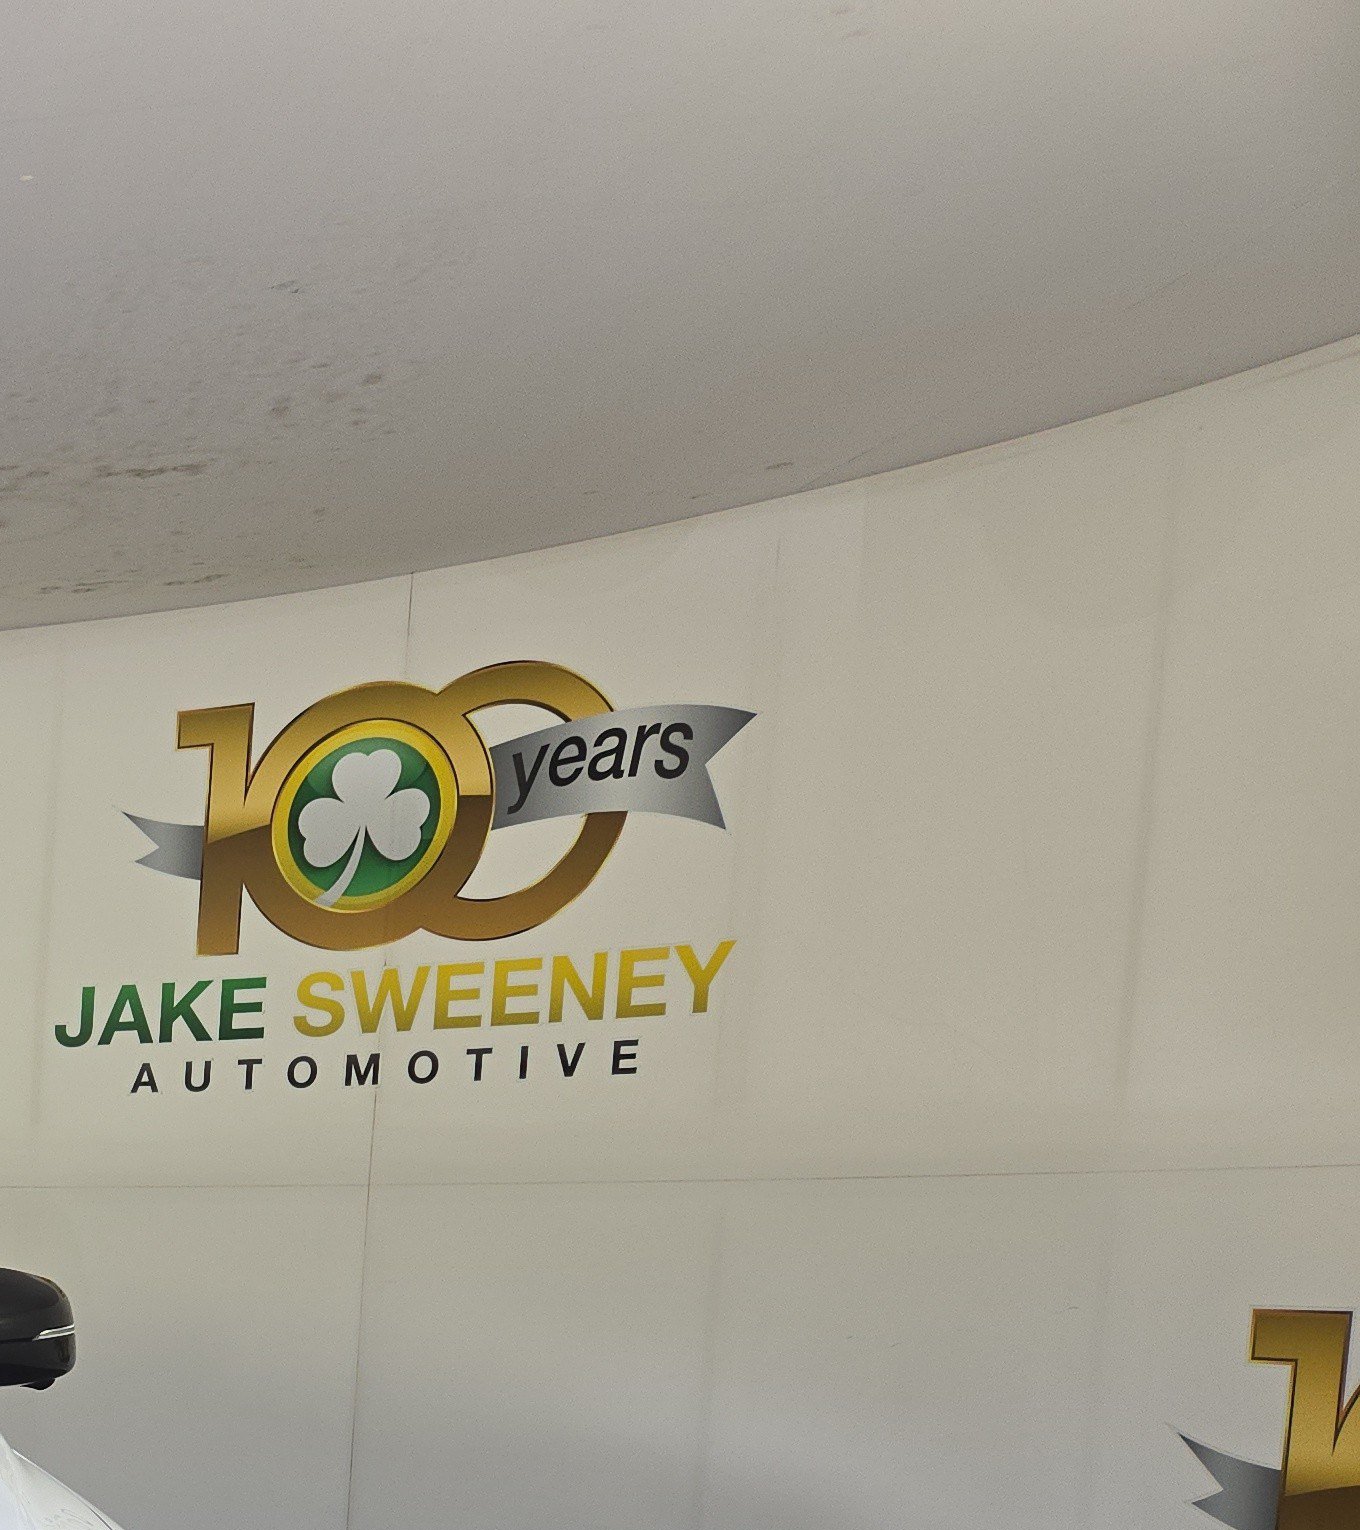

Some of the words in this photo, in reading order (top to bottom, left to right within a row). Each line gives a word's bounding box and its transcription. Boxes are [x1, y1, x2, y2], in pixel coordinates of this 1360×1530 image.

[176, 660, 629, 957] 100
[506, 721, 694, 814] years
[54, 976, 267, 1047] JAKE
[292, 940, 737, 1037] SWEENEY
[130, 1039, 640, 1094] AUTOMOTIVE
